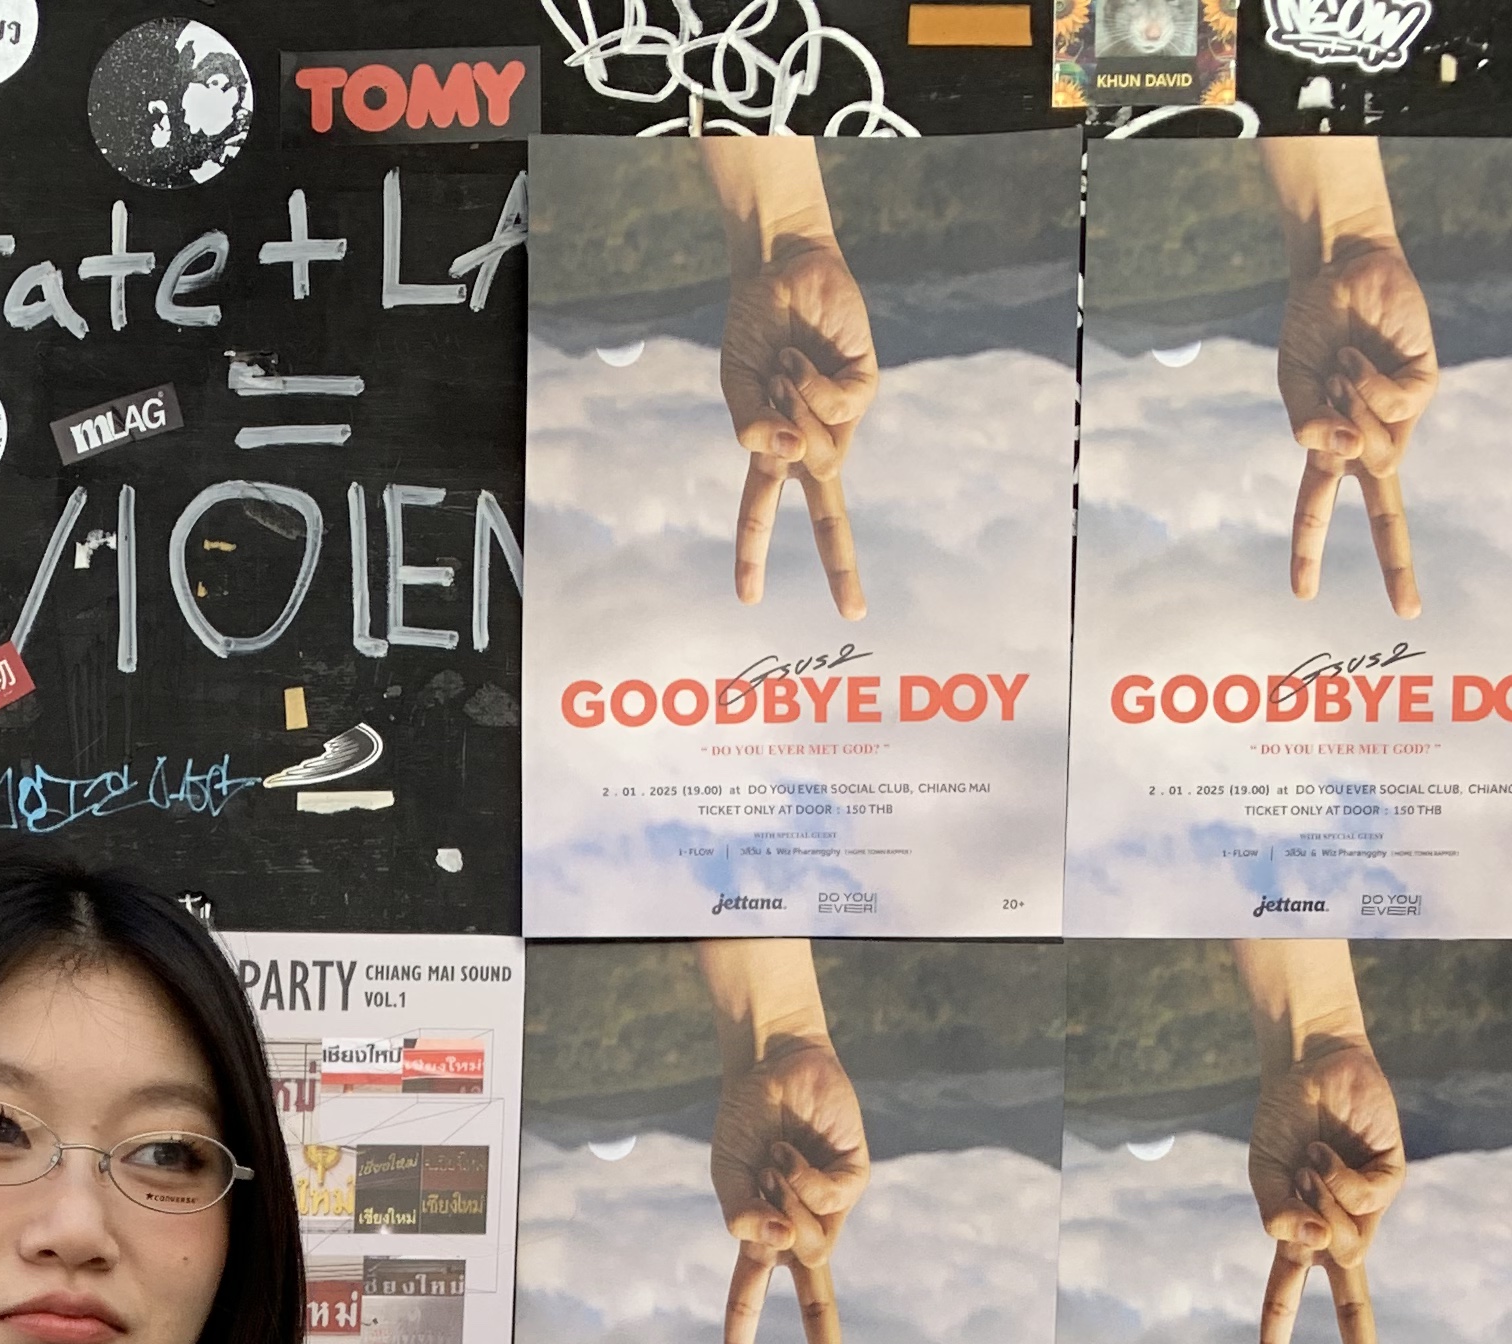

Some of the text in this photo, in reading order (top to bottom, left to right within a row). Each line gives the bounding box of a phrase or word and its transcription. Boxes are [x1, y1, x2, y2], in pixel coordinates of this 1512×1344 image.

[1096, 72, 1193, 88] KHUN DAVID
[295, 60, 527, 134] TOMY
[560, 672, 1031, 729] GOODBYE DOY
[1110, 673, 1435, 725] GOODBYE
[711, 743, 880, 756] DO YOU EVER MET GOD?
[649, 785, 678, 797] 2025
[729, 785, 741, 796] at
[748, 784, 768, 795] DO
[769, 783, 796, 795] YOU
[797, 783, 829, 795] EVER
[830, 783, 876, 795] SOCIAL
[917, 782, 967, 794] CHIANG
[968, 782, 991, 794] MAI
[697, 803, 893, 817] TICKET ONLY AT DOOR 150 THB
[1002, 898, 1025, 910] 20+
[238, 959, 512, 1012] PARTY CHIANG MAI SOUND
[364, 991, 406, 1008] VOL.1
